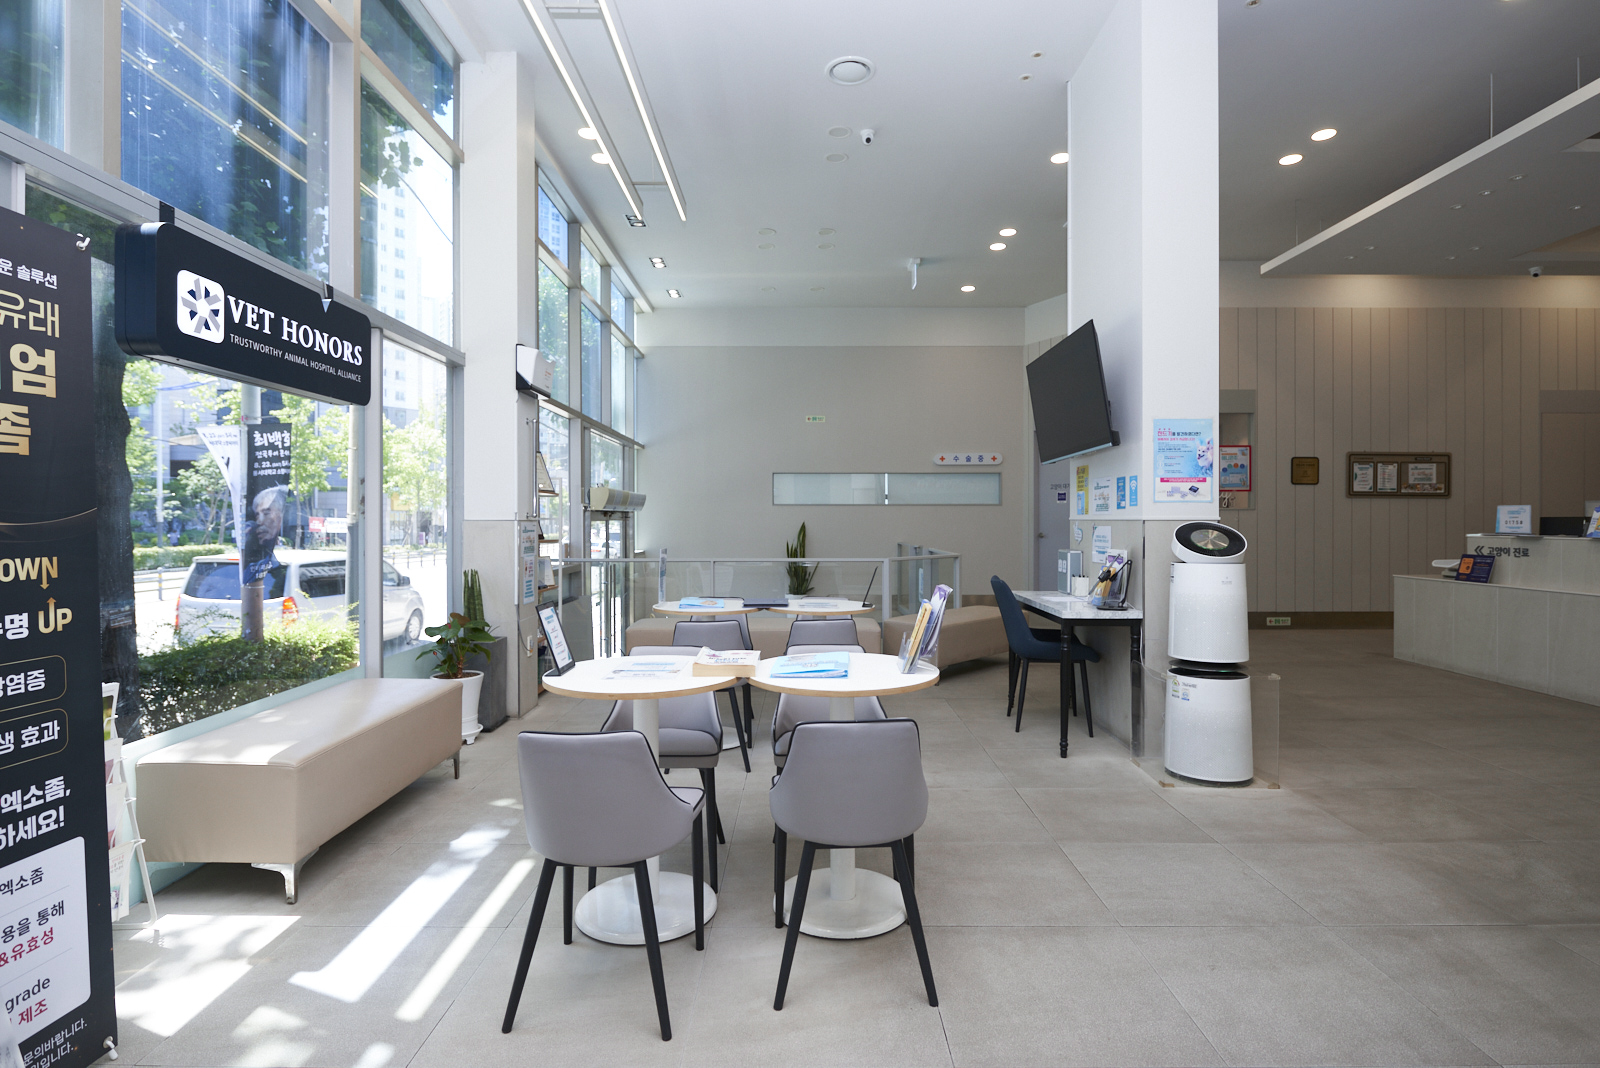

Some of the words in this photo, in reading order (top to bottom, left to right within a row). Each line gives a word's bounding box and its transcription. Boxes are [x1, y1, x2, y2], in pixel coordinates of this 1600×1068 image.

[17, 264, 58, 290] 솔루션
[0, 289, 60, 338] 유래
[227, 294, 274, 335] VET
[281, 316, 363, 366] HONORS
[10, 343, 56, 398] 엄
[230, 334, 282, 358] TRUSTWORTHY
[284, 353, 309, 367] ANIMAL
[310, 360, 336, 375] HOSPITAL
[337, 369, 361, 383] ALLIANCE
[1487, 546, 1511, 557] 고양이
[1513, 547, 1530, 557] 진료
[0, 556, 58, 590] OWN
[0, 612, 30, 640] 명
[38, 597, 72, 634] UP
[0, 668, 46, 698] 염증
[20, 720, 60, 748] 효과
[0, 776, 71, 814] 엑소좀,
[0, 805, 65, 850] 하세요!
[36, 900, 64, 926] 통해
[0, 927, 54, 968] &유효성
[5, 976, 51, 1014] grade
[18, 998, 48, 1026] 제조
[23, 1017, 88, 1067] 문의바랍니다.
